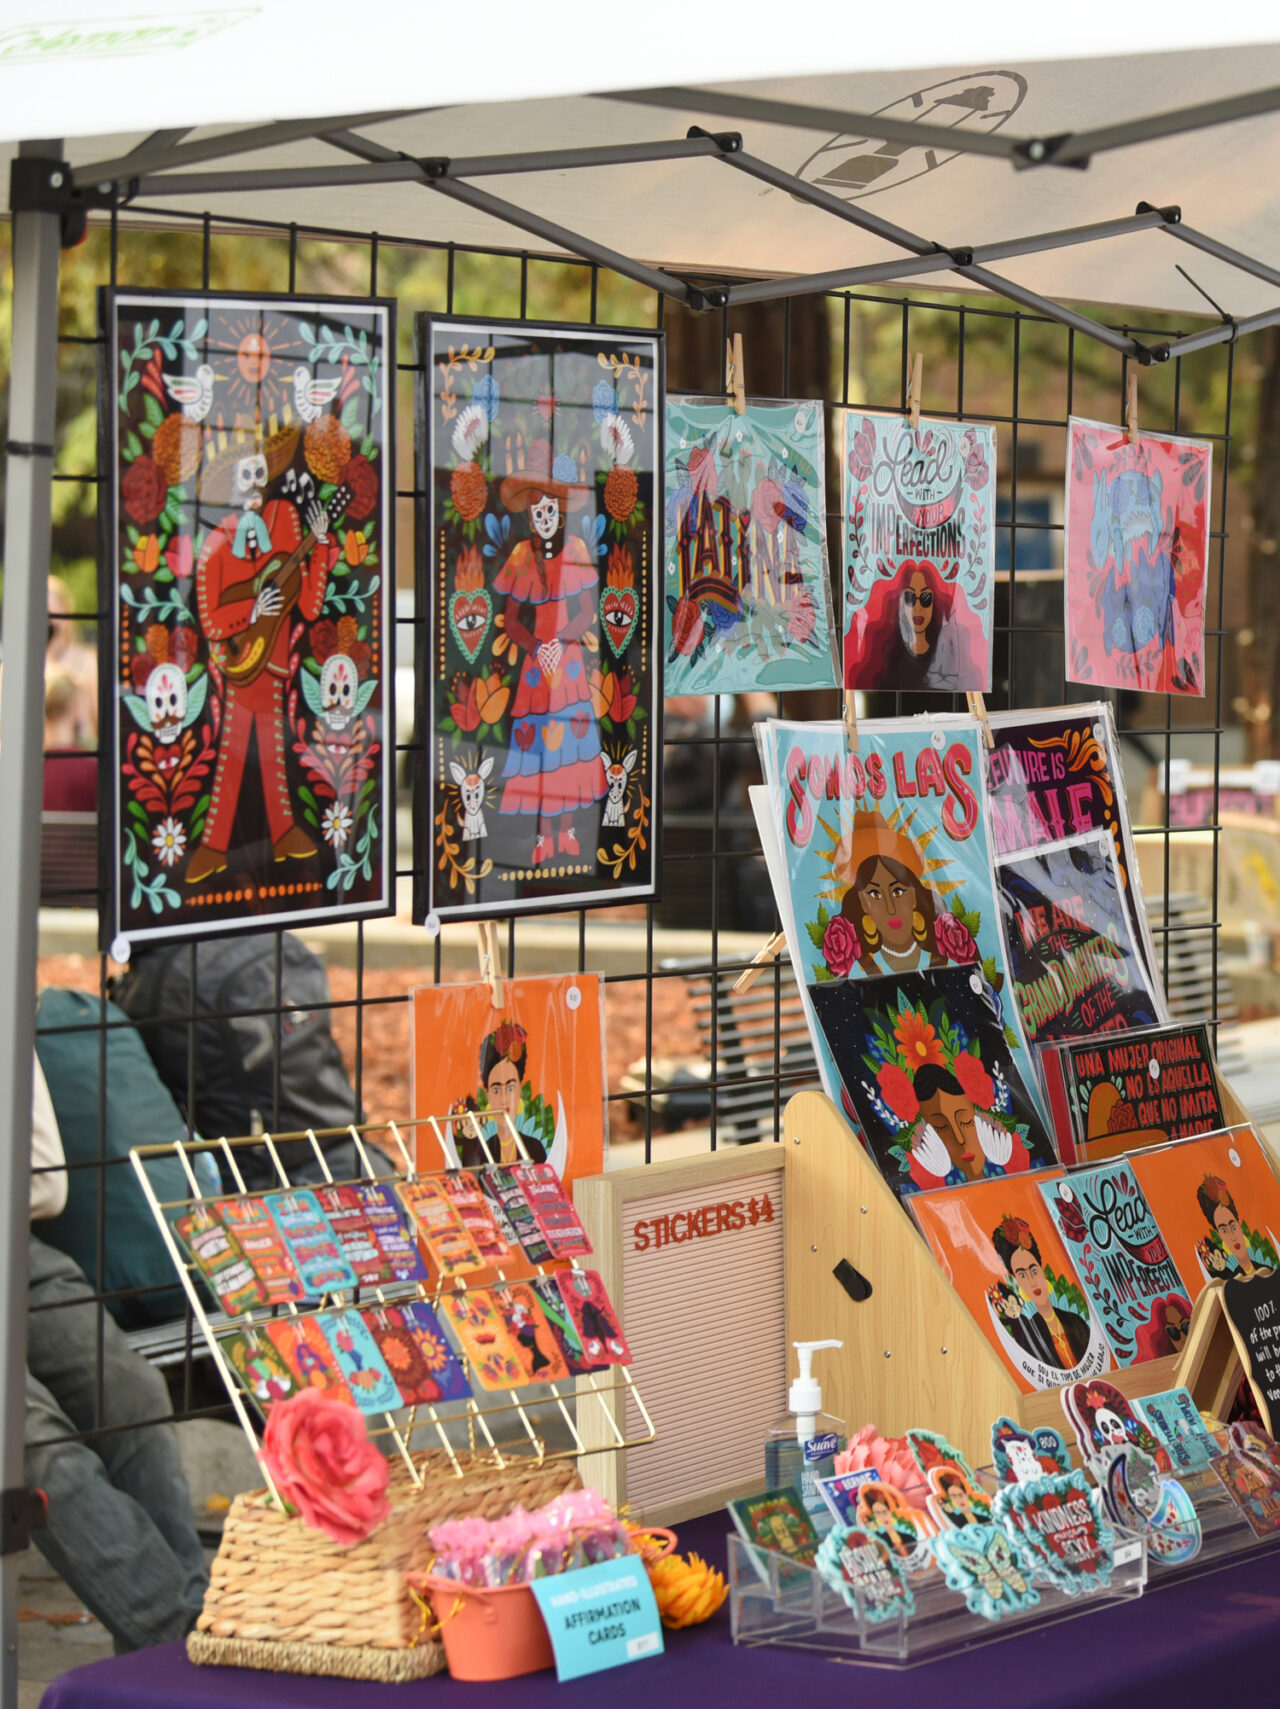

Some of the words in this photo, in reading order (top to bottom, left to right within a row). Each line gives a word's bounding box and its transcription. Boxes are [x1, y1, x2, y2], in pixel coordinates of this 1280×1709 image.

[873, 431, 953, 498] Lead
[871, 502, 966, 559] IMPERFECTIONS
[919, 503, 945, 525] YOUR
[990, 749, 1050, 788] FUTURE
[1051, 752, 1066, 780] IS
[786, 745, 888, 849] SOMOS
[893, 742, 979, 842] LAS
[988, 782, 1093, 856] MALE
[1015, 906, 1040, 949] WE
[1051, 895, 1091, 932] ARE
[1047, 934, 1071, 952] THE
[1013, 922, 1130, 1040] GRANDDAUGHTERS
[1081, 1001, 1097, 1028] OF
[1094, 983, 1116, 1016] THE
[1075, 1052, 1105, 1077] UNA
[1108, 1044, 1150, 1072] MUJER
[1151, 1036, 1202, 1064] ORIGINAL
[1126, 1075, 1144, 1100] NO
[1162, 1062, 1212, 1093] AQUELLA
[1138, 1100, 1161, 1127] QUE
[1161, 1097, 1178, 1122] NO
[1180, 1089, 1218, 1119] IMITA
[634, 1201, 746, 1251] STICKERS
[748, 1193, 775, 1226] $4
[1083, 1179, 1149, 1250] Lead
[1134, 1228, 1154, 1240] WITH
[1101, 1252, 1182, 1304] IMPERFECTI
[1250, 1328, 1259, 1344] of
[1259, 1326, 1273, 1341] the
[1255, 1345, 1272, 1363] will
[1022, 1360, 1036, 1378] QUE
[1073, 1370, 1082, 1379] DE
[1081, 1351, 1095, 1374] MUJER
[1265, 1368, 1276, 1383] to
[808, 1436, 837, 1452] Suave
[1038, 1436, 1057, 1449] BOO
[1032, 1499, 1093, 1534] KINDNESS
[565, 1598, 642, 1630] AFFIRMATION
[587, 1622, 627, 1646] CARDS
